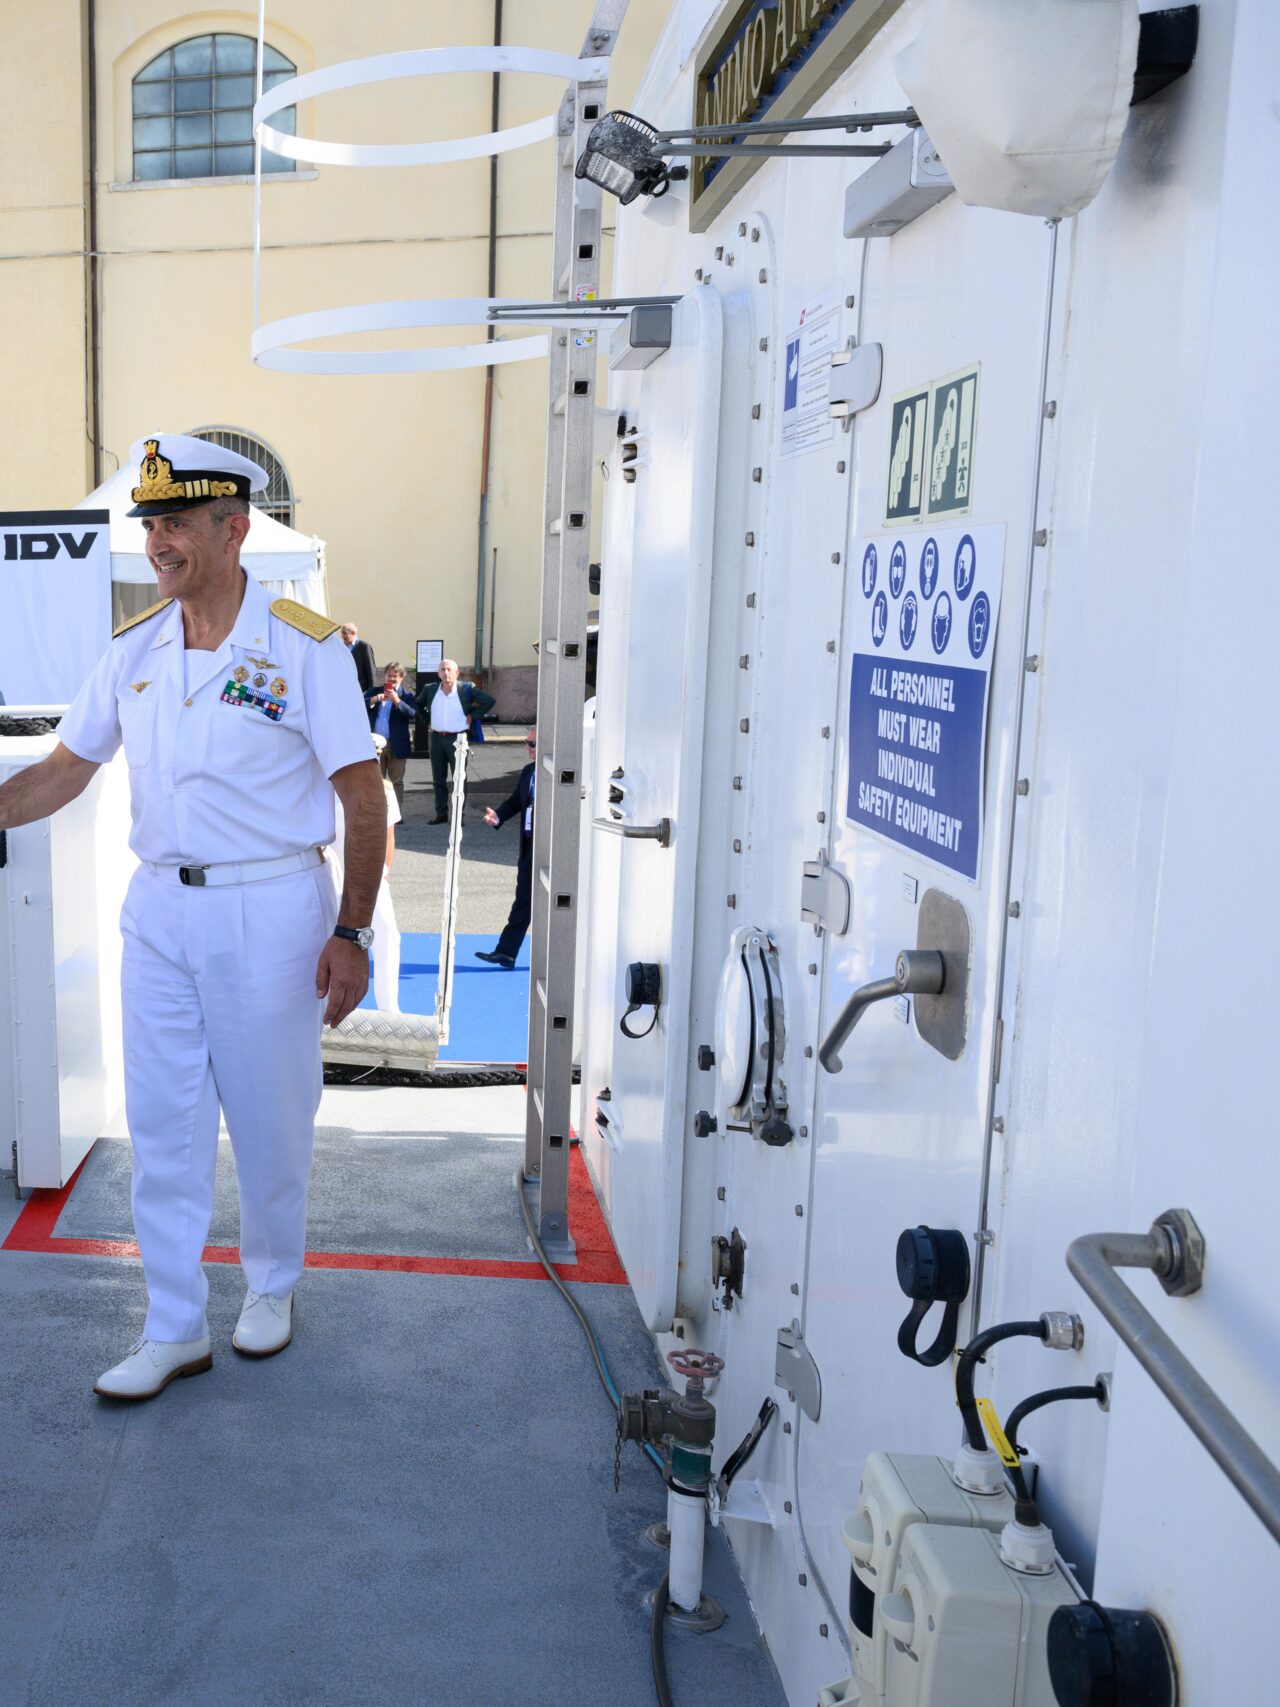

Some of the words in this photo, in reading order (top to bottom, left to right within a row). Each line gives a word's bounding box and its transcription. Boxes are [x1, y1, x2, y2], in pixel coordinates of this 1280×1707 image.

[4, 532, 98, 560] IDV
[870, 667, 887, 698] ALL
[891, 670, 955, 713] PERSONNEL
[878, 708, 907, 743] MUST
[910, 716, 941, 754] WEAR
[878, 749, 936, 798] INDIVIDUAL
[858, 781, 894, 822] SAFETY
[895, 796, 962, 852] EQUIPMENT
